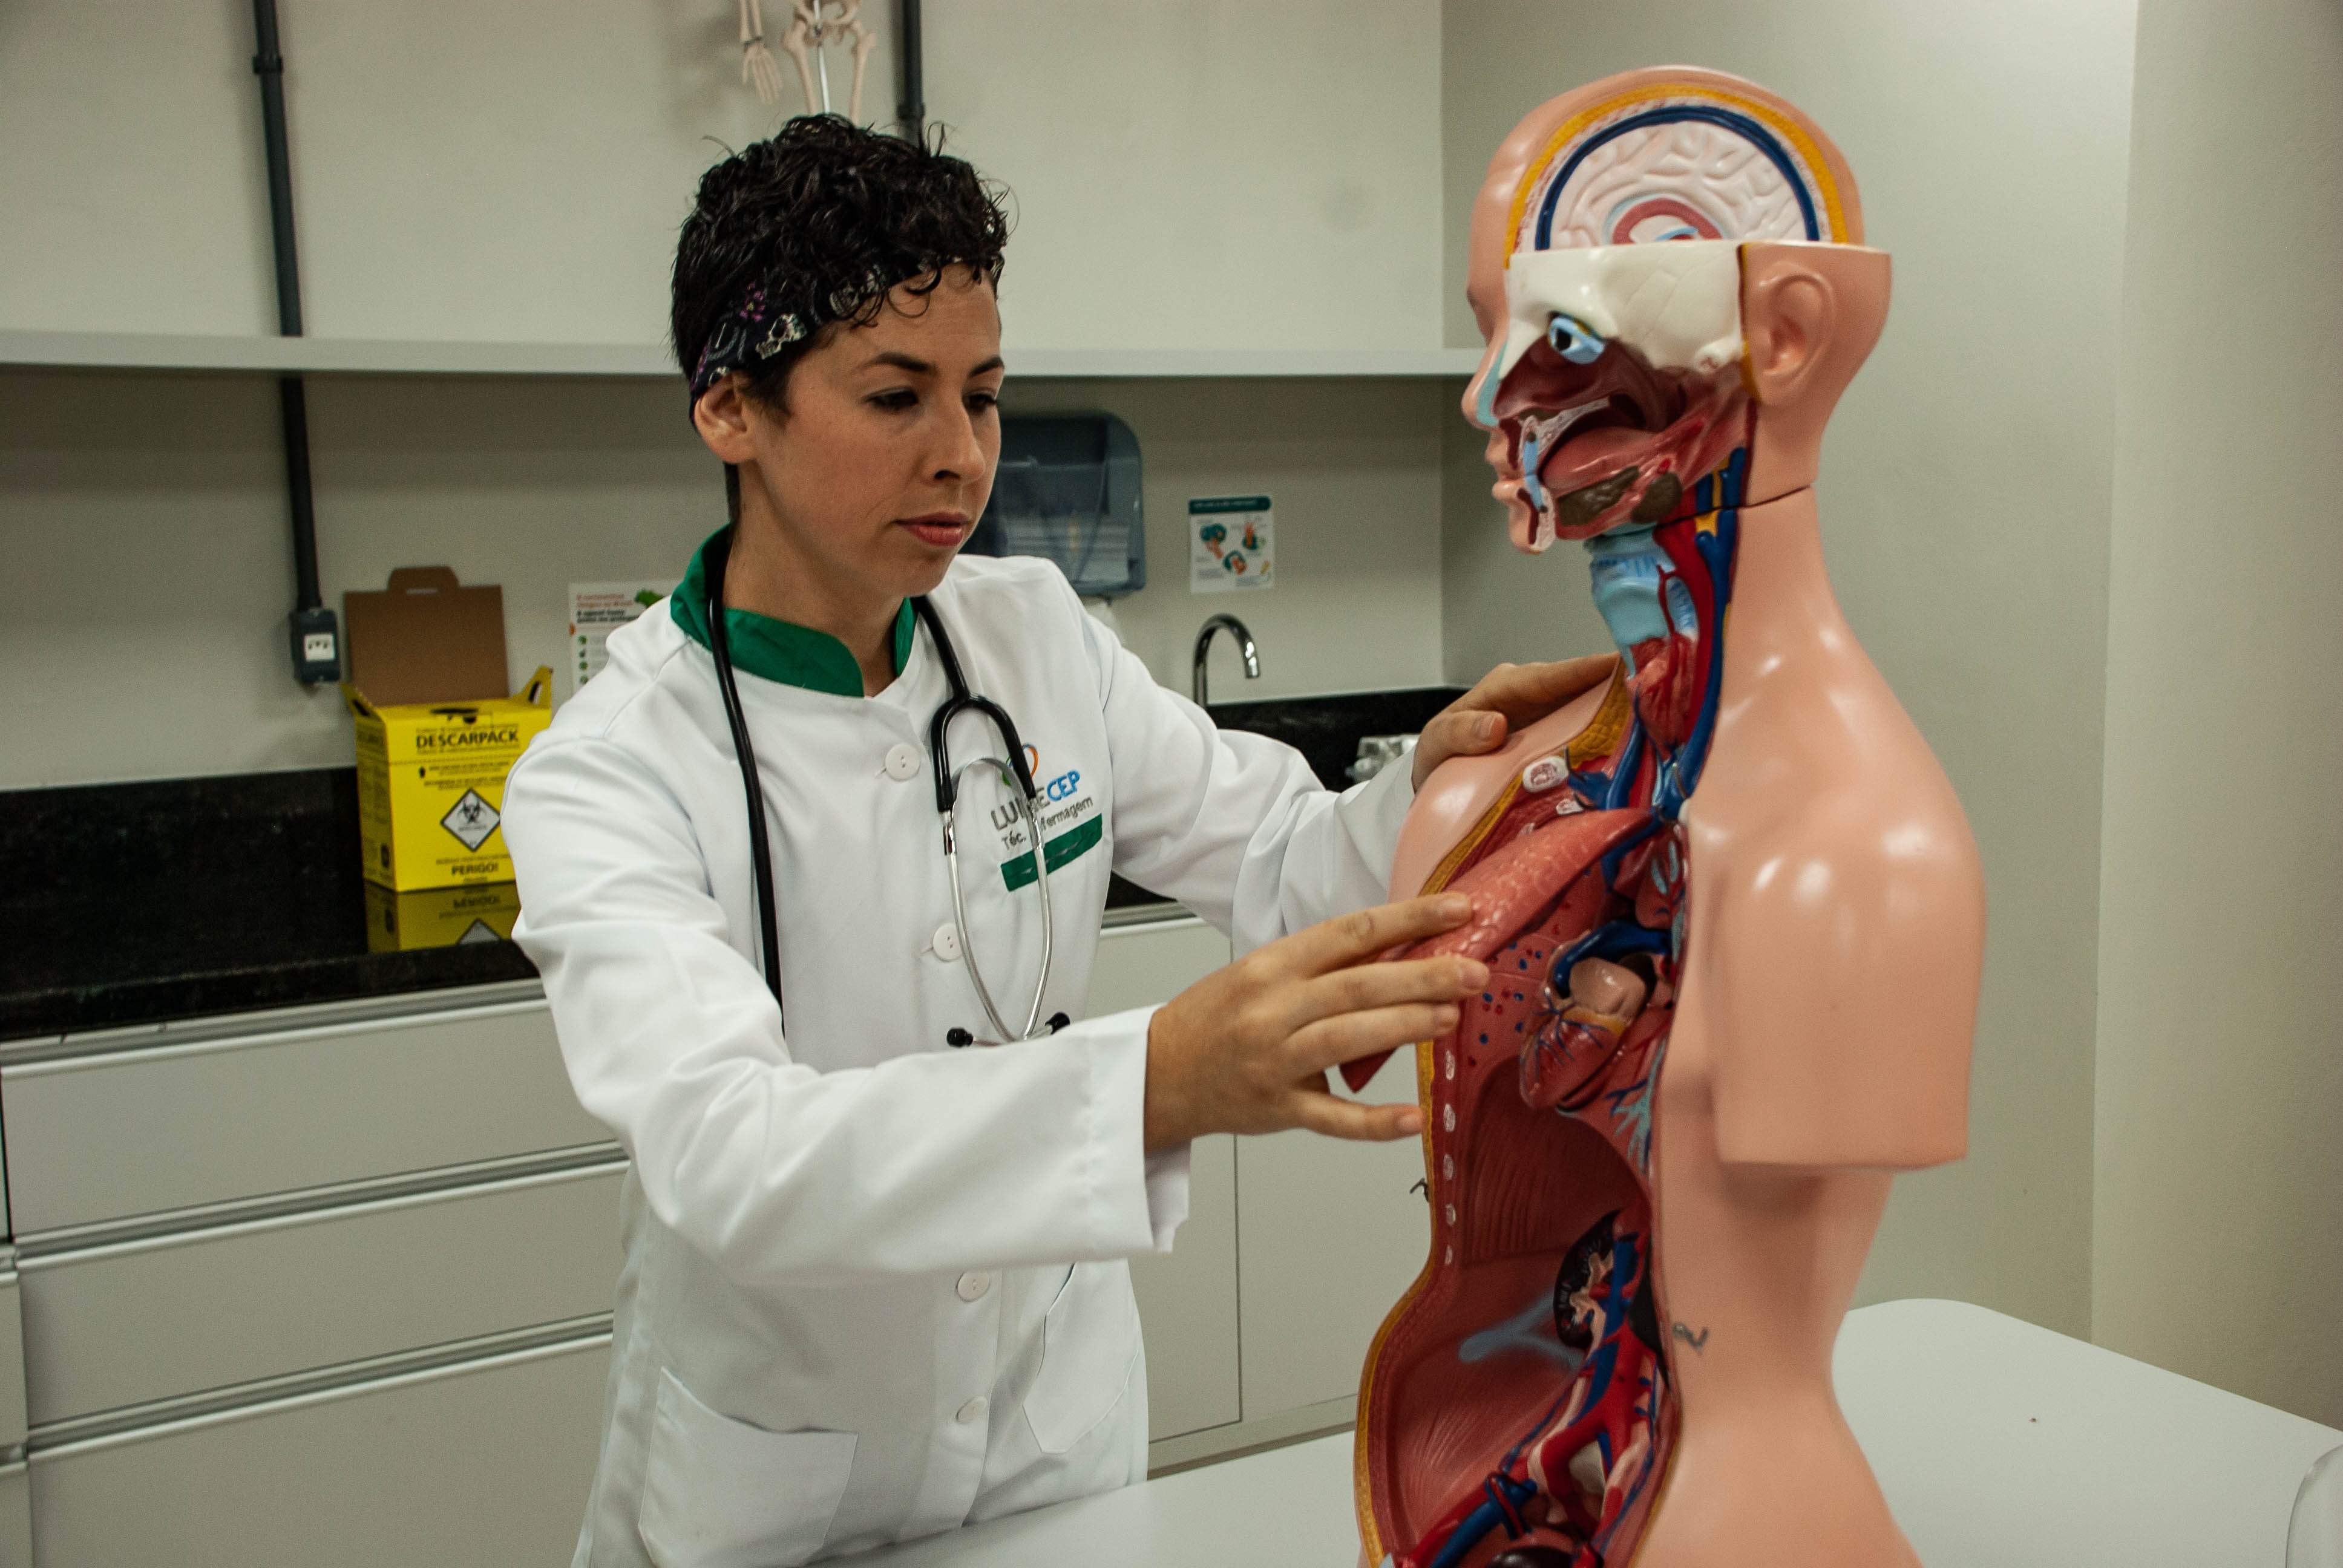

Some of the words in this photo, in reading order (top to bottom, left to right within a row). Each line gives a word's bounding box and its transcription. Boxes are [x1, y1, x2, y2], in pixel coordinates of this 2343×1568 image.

[416, 730, 519, 748] DESCARPACK
[991, 770, 1080, 831] LUECEP
[1001, 830, 1026, 851] Téc.
[451, 863, 499, 875] PERIGO!
